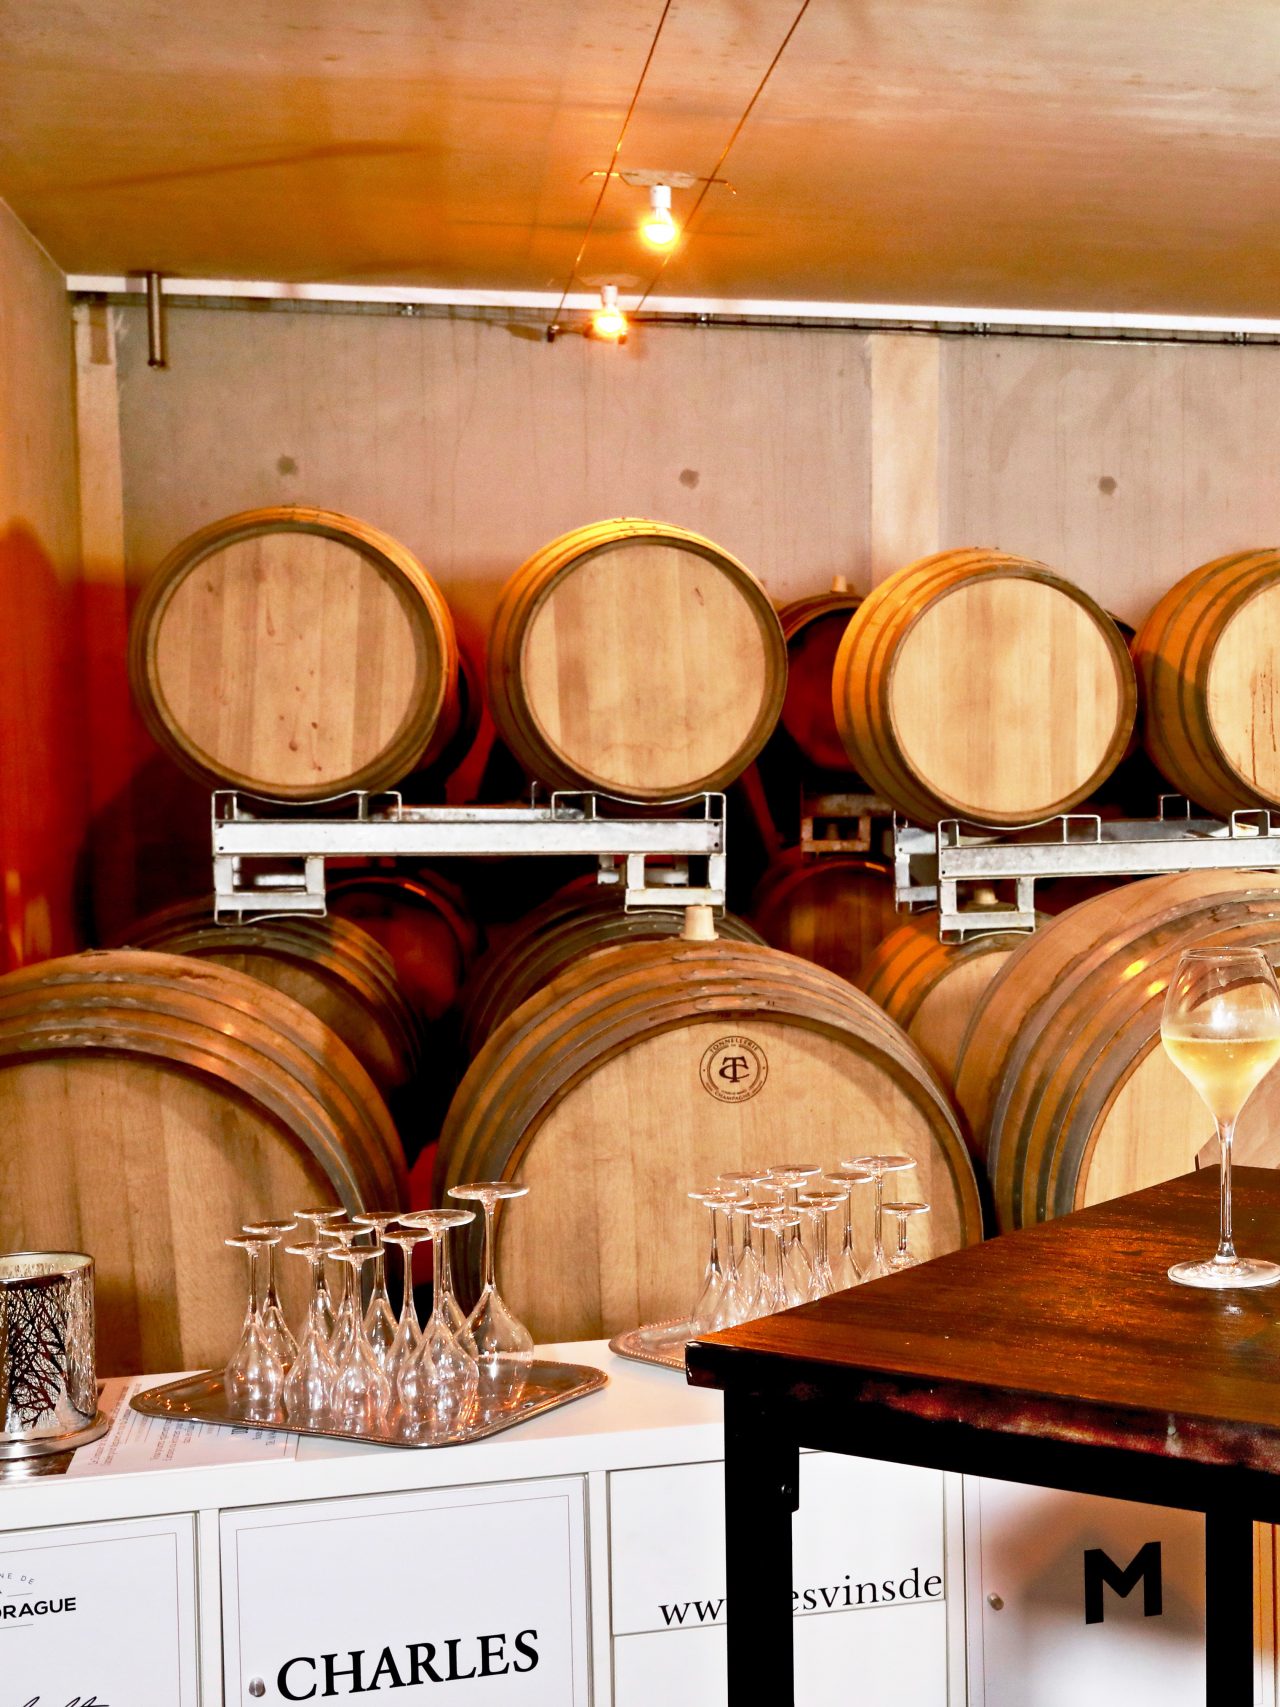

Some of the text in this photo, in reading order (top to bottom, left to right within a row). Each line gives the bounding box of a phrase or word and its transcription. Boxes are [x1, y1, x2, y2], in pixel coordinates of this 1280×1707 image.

[20, 1575, 35, 1585] DE
[1083, 1541, 1163, 1625] M
[0, 1597, 77, 1620] RAGUE
[276, 1629, 540, 1702] CHARLES
